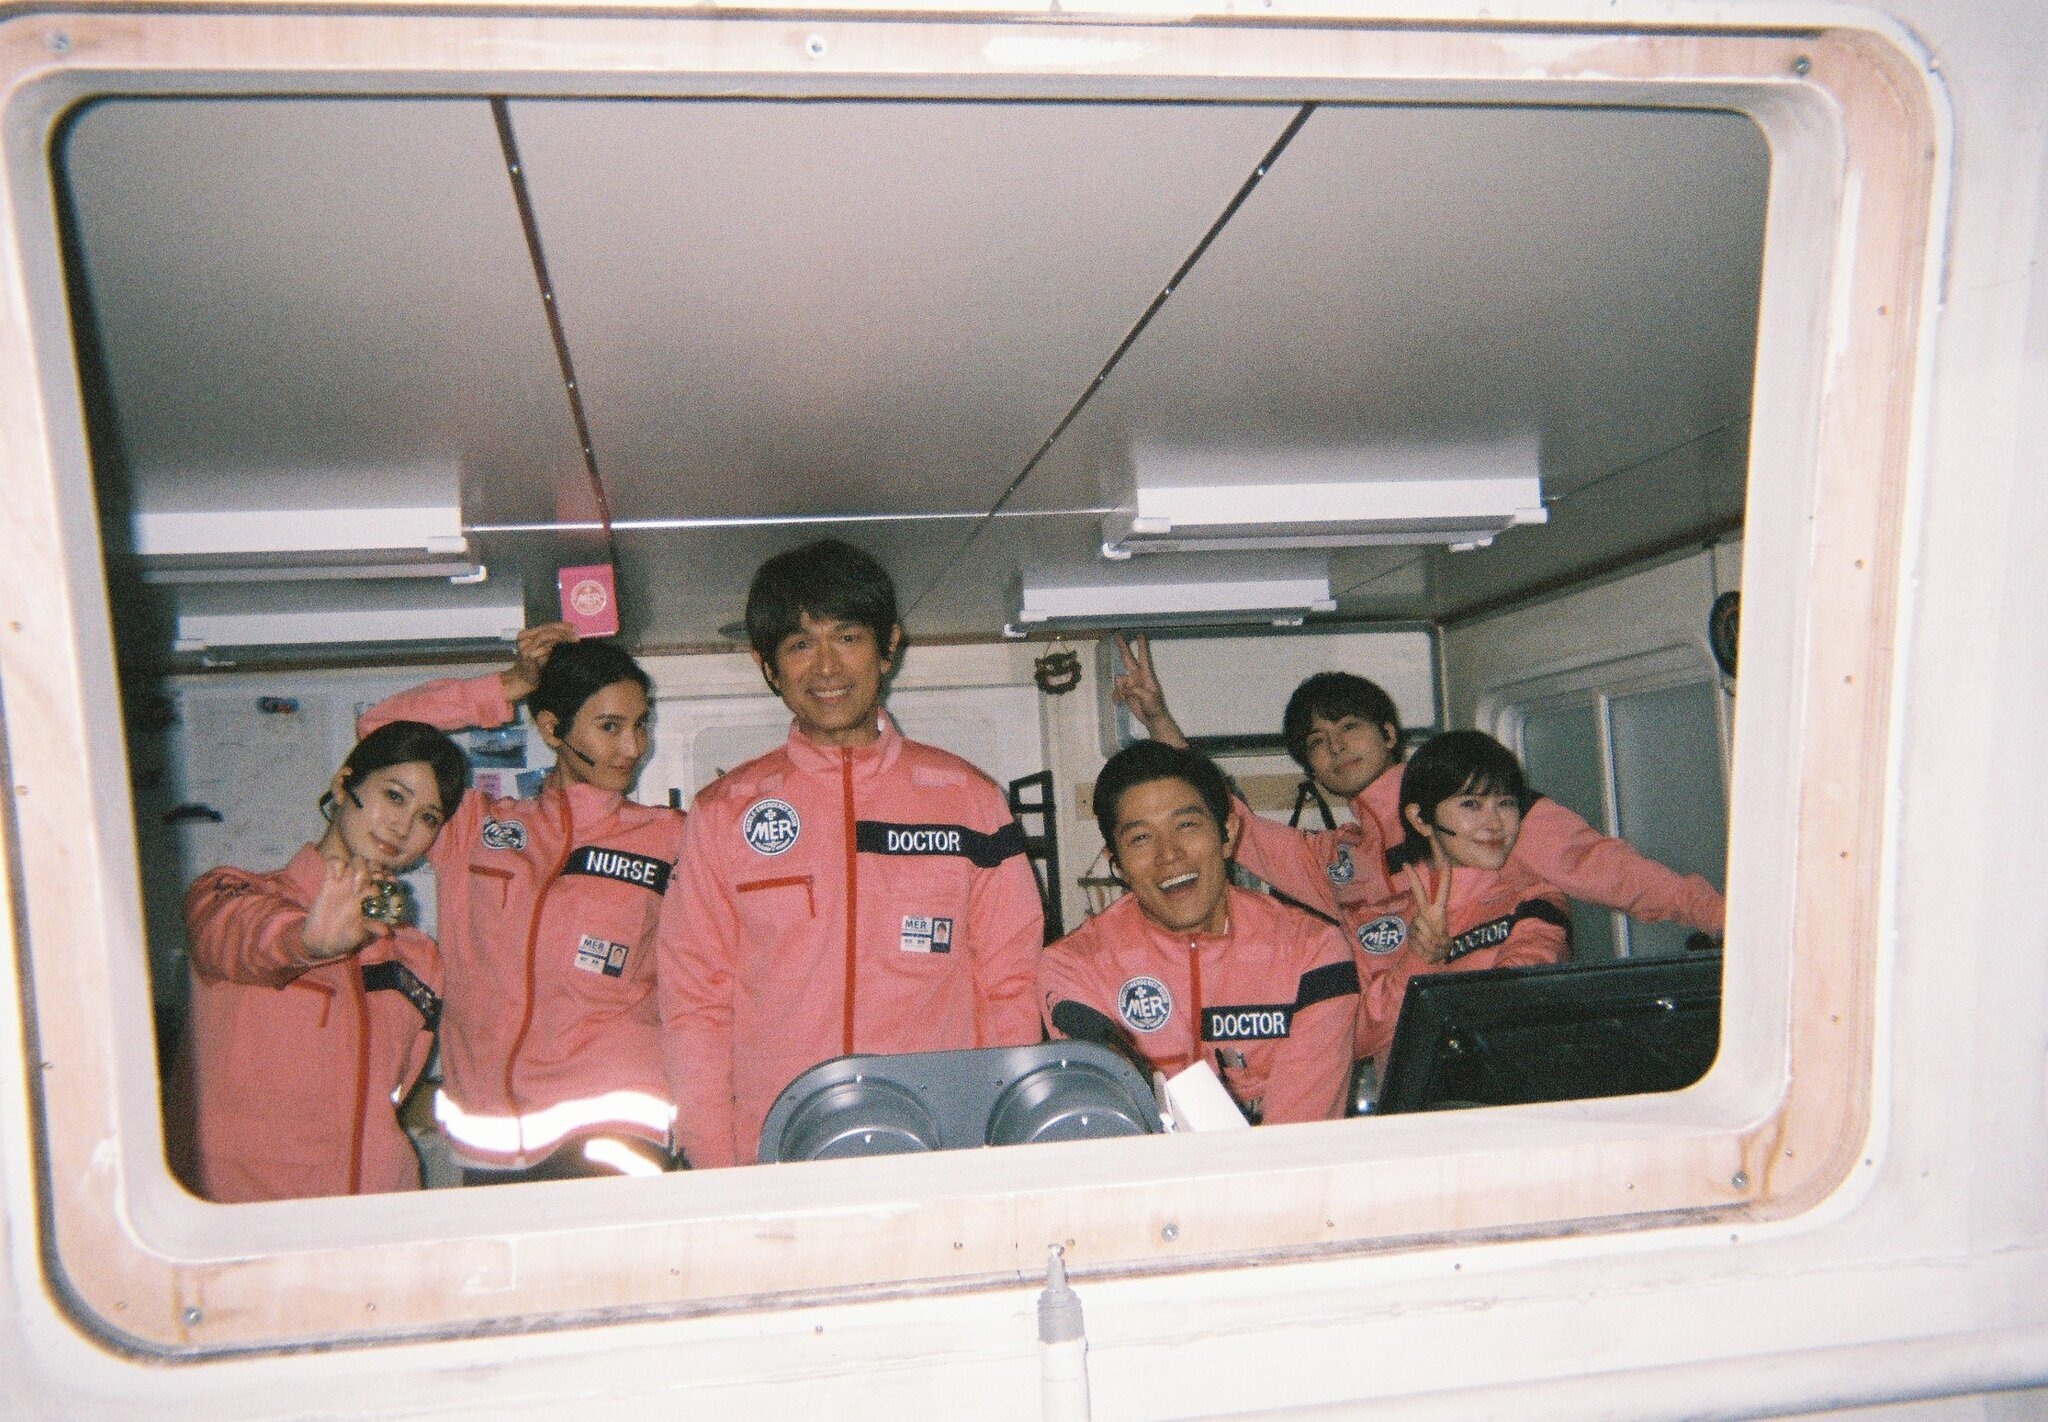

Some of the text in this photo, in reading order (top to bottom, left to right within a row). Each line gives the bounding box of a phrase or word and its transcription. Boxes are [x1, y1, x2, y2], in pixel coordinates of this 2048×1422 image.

[750, 819, 795, 842] MER
[887, 830, 961, 852] DOCTOR
[586, 850, 658, 885] NURSE
[905, 919, 928, 930] MER
[583, 938, 605, 950] MER
[1361, 929, 1399, 945] MER
[1449, 920, 1509, 957] DOCTOR
[1125, 995, 1168, 1018] MER
[1212, 1011, 1287, 1037] DOCTOR
